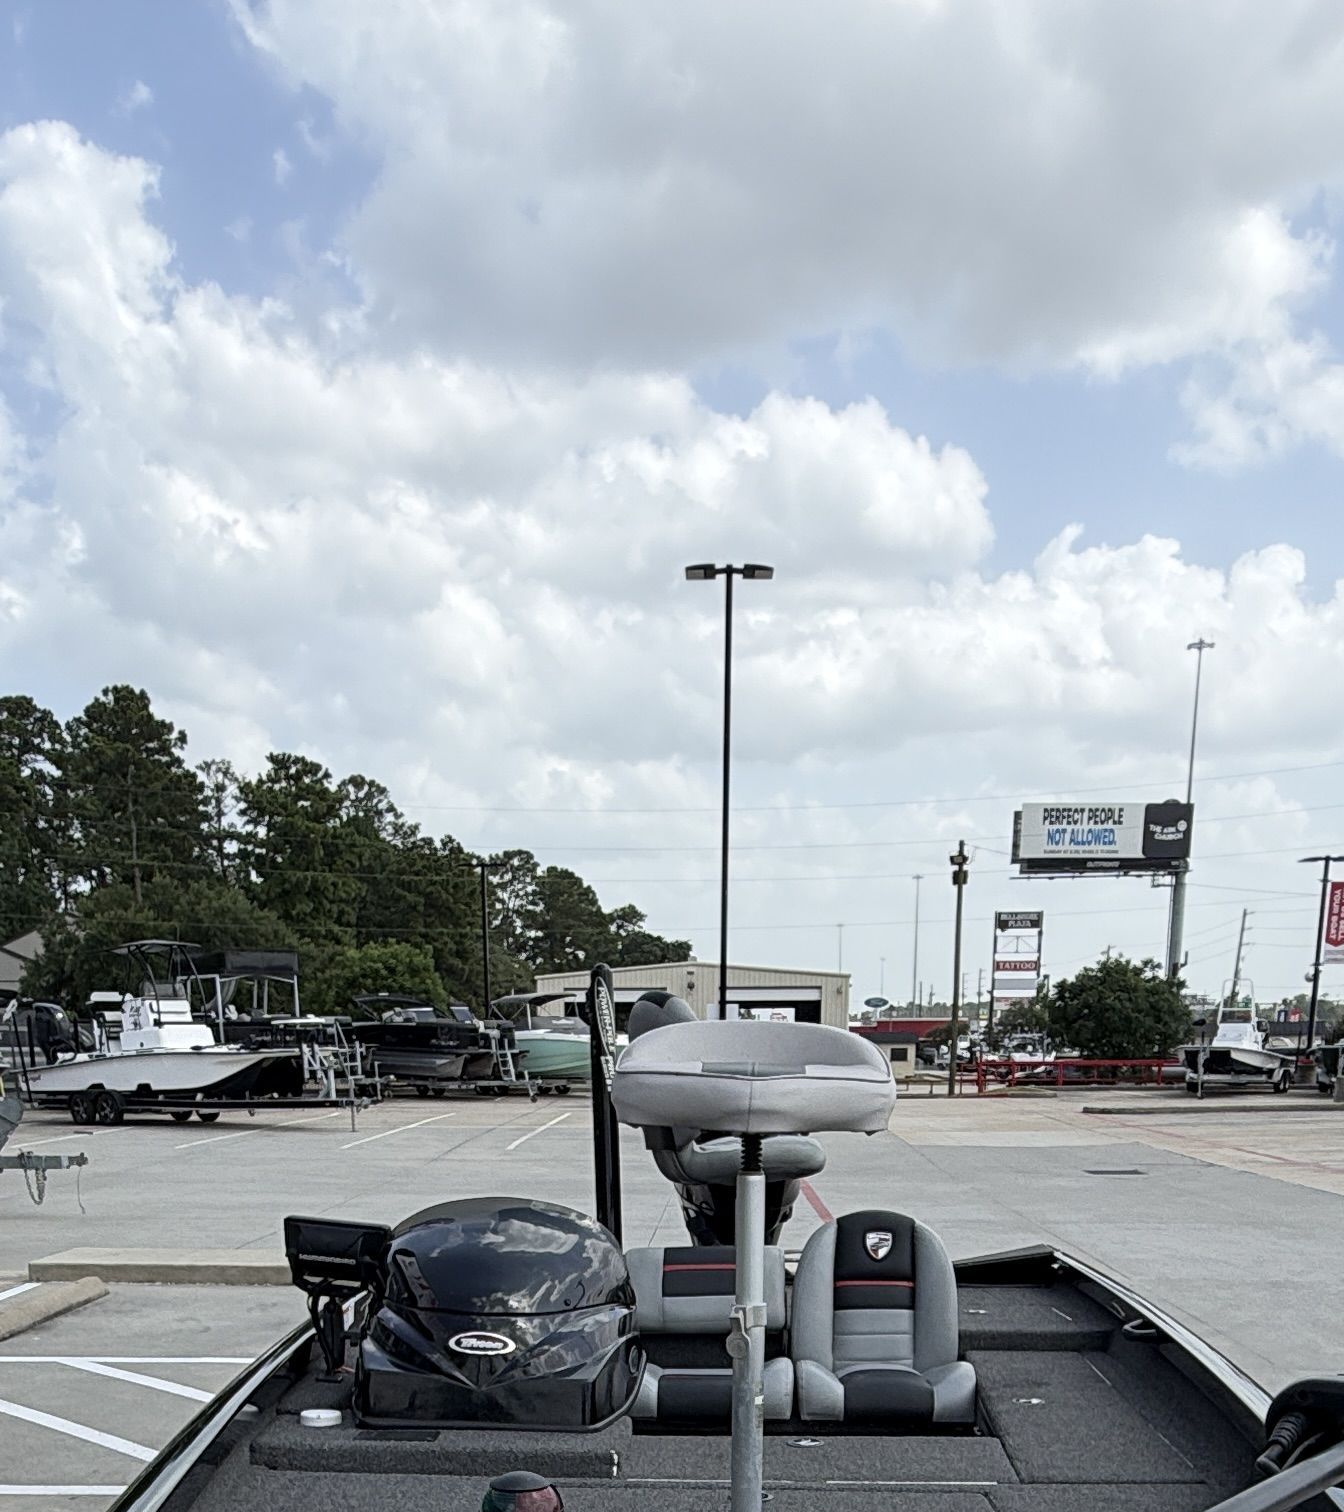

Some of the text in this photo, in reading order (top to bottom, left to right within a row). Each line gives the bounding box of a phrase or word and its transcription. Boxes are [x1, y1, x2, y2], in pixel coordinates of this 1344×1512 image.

[1042, 807, 1124, 825] PERFECT PEOPLE
[1046, 828, 1117, 846] NOT ALLOWED.
